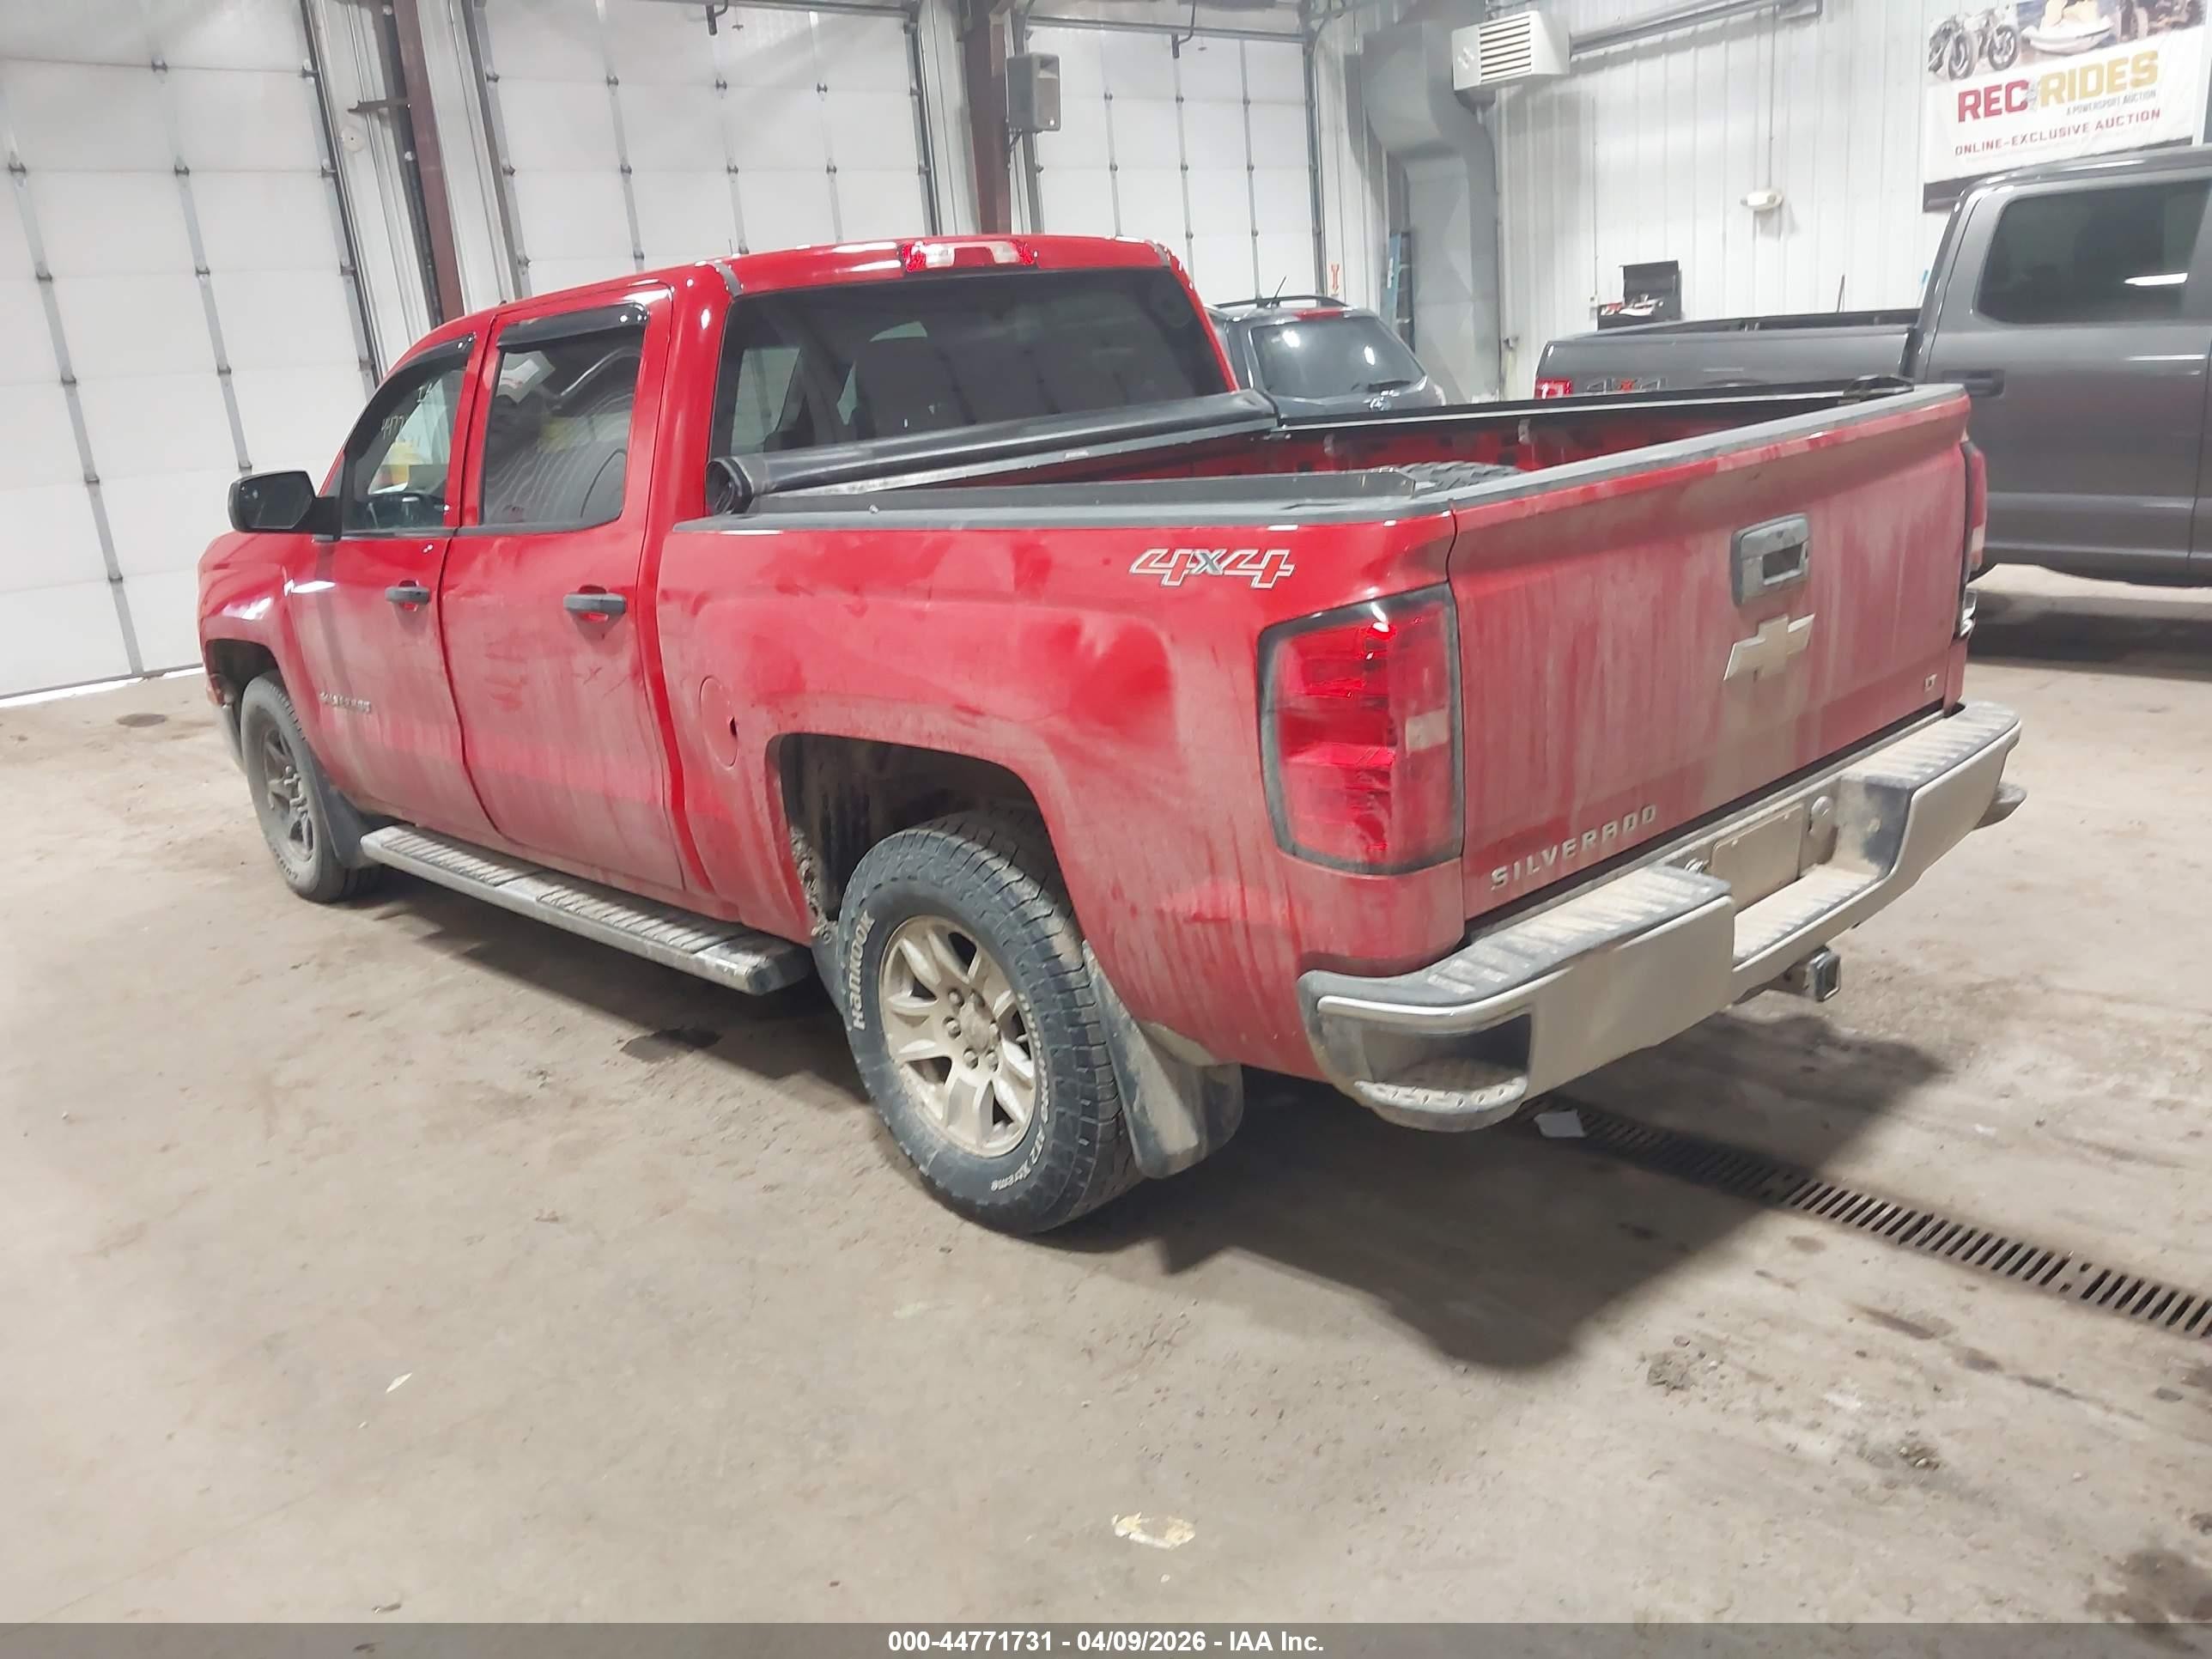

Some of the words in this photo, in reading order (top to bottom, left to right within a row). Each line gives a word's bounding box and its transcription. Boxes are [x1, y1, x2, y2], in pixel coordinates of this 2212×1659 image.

[1958, 80, 2029, 124] REC
[2039, 50, 2159, 108] RIDES
[2123, 89, 2156, 104] AUCTION
[1954, 122, 2090, 156] ONLINE-EXCLUSIVE
[2094, 108, 2161, 131] AUCTION
[1491, 804, 1657, 890] SILVERADO
